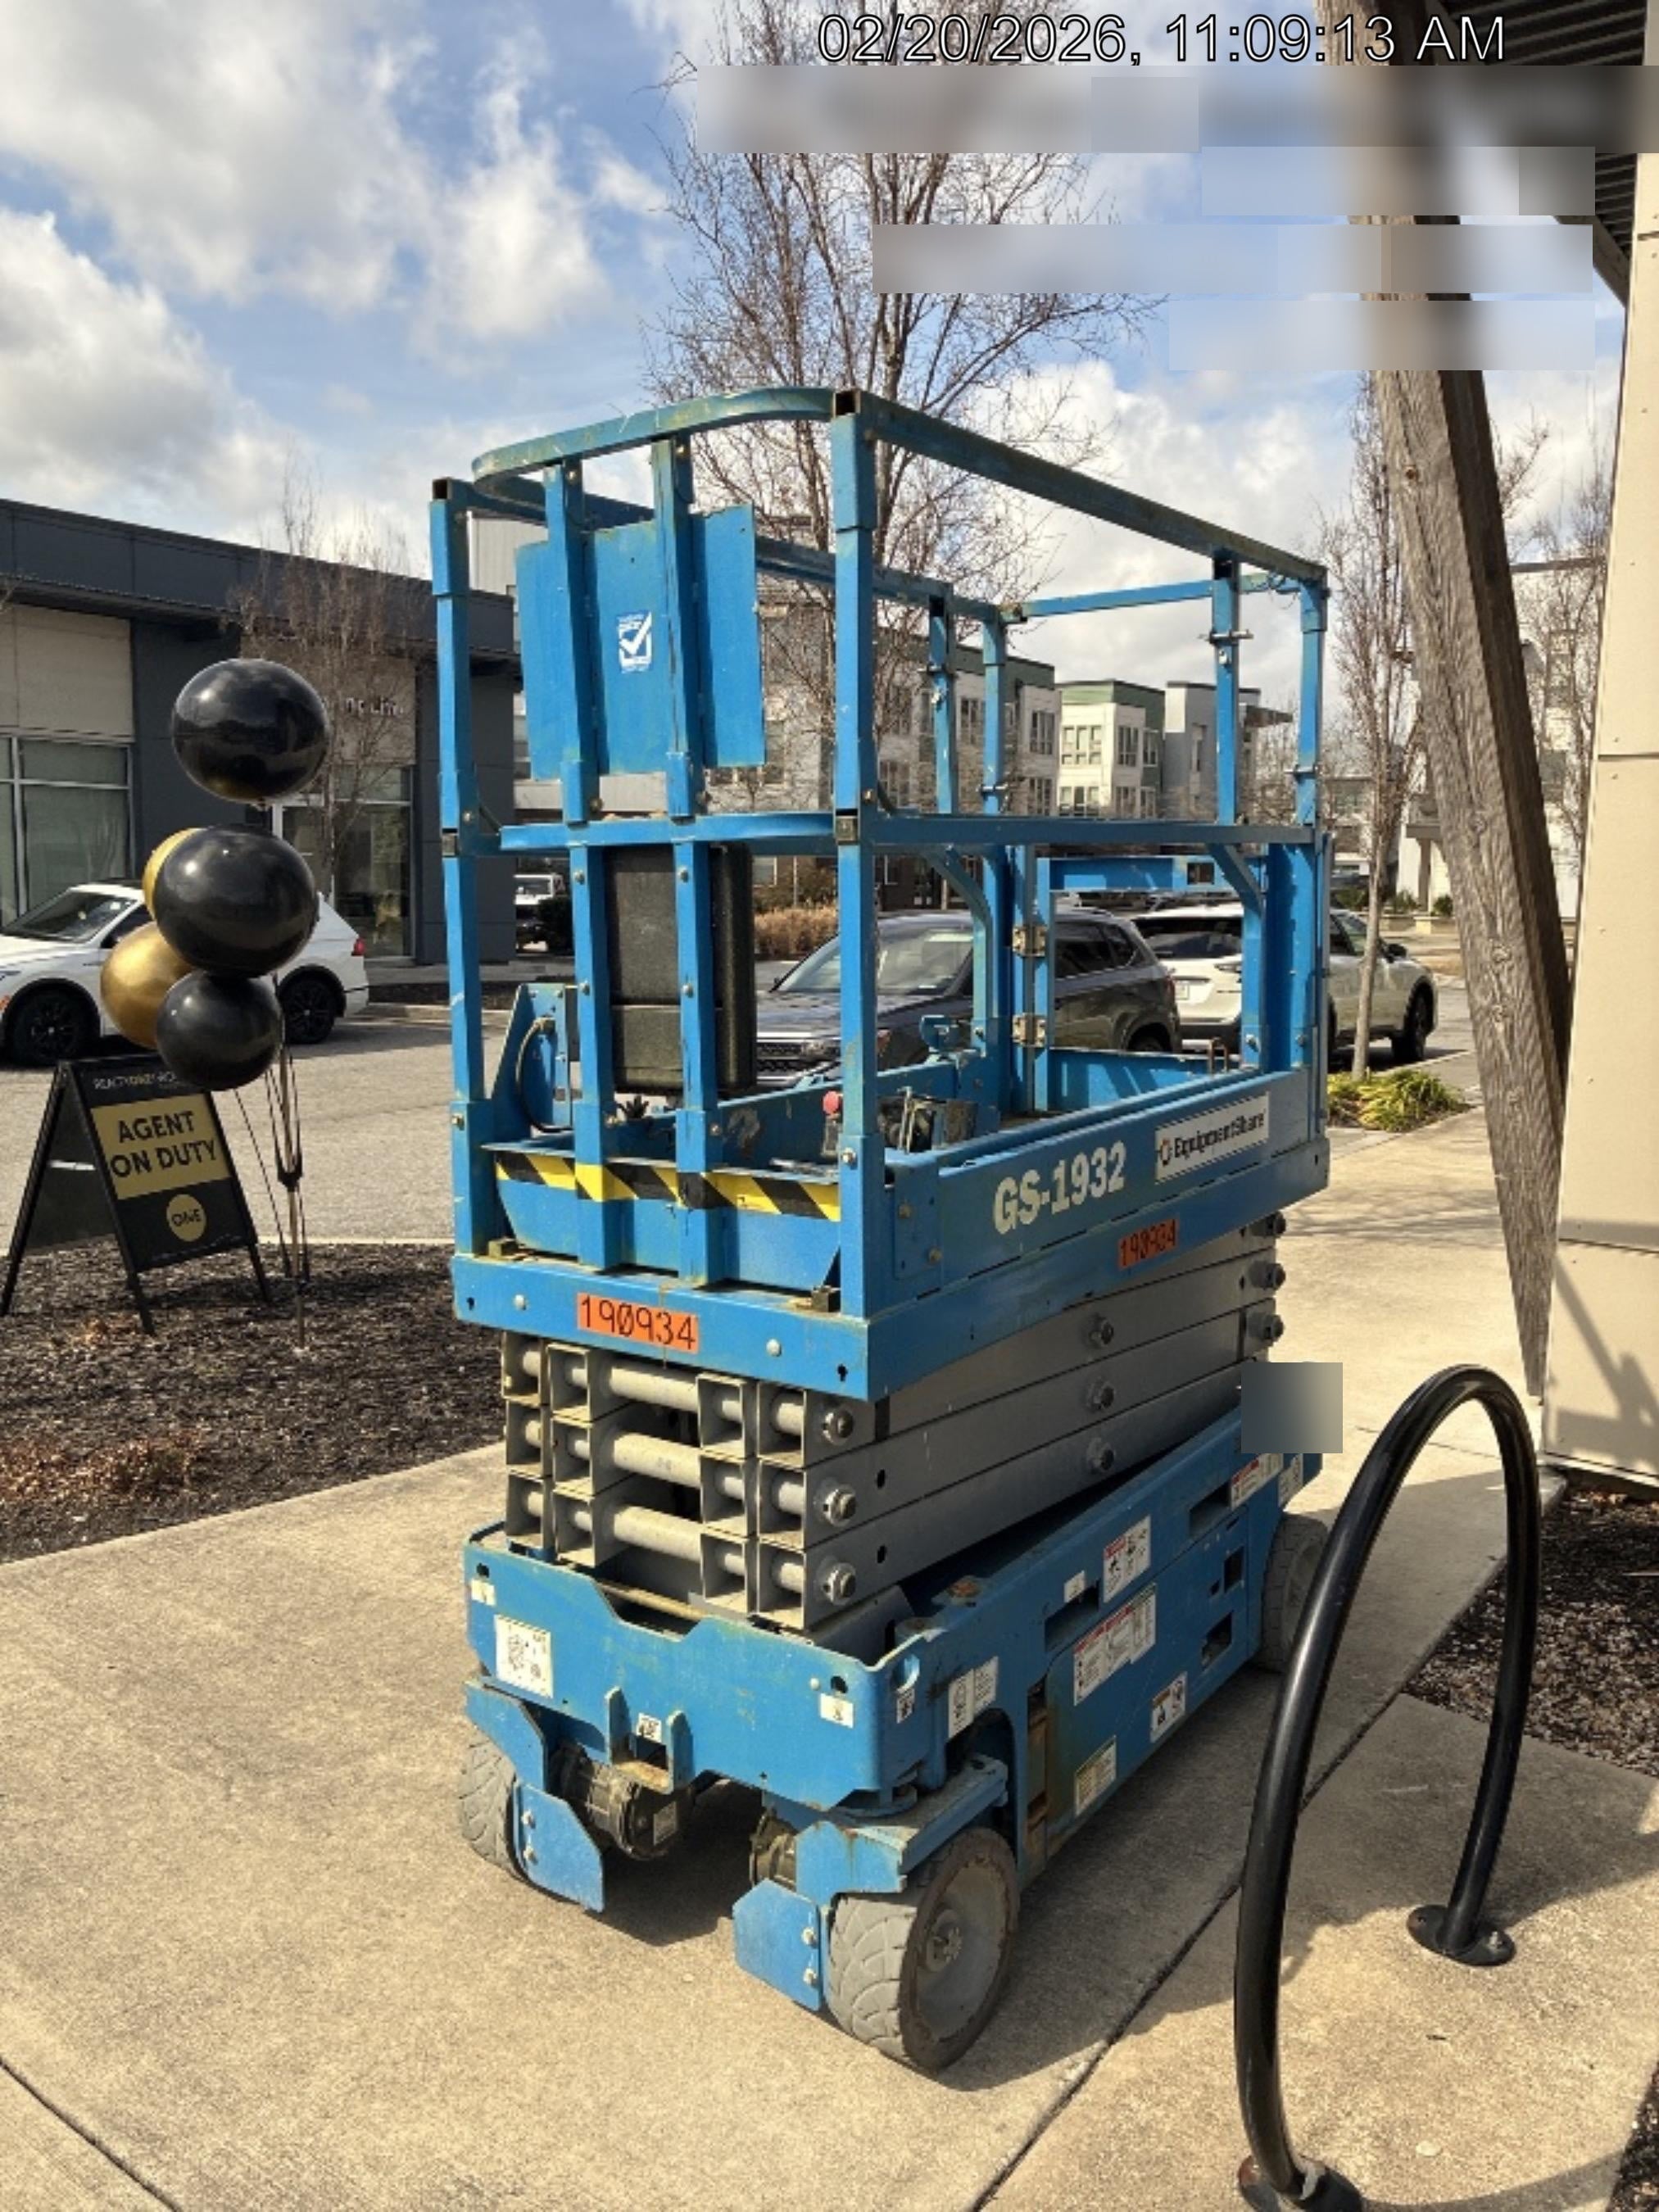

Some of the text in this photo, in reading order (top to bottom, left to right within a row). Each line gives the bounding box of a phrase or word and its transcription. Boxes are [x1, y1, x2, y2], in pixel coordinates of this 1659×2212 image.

[118, 1110, 194, 1143] AGENT
[110, 1138, 216, 1177] ON DUTY
[994, 1140, 1126, 1235] GS-1932
[581, 1294, 696, 1350] 190934
